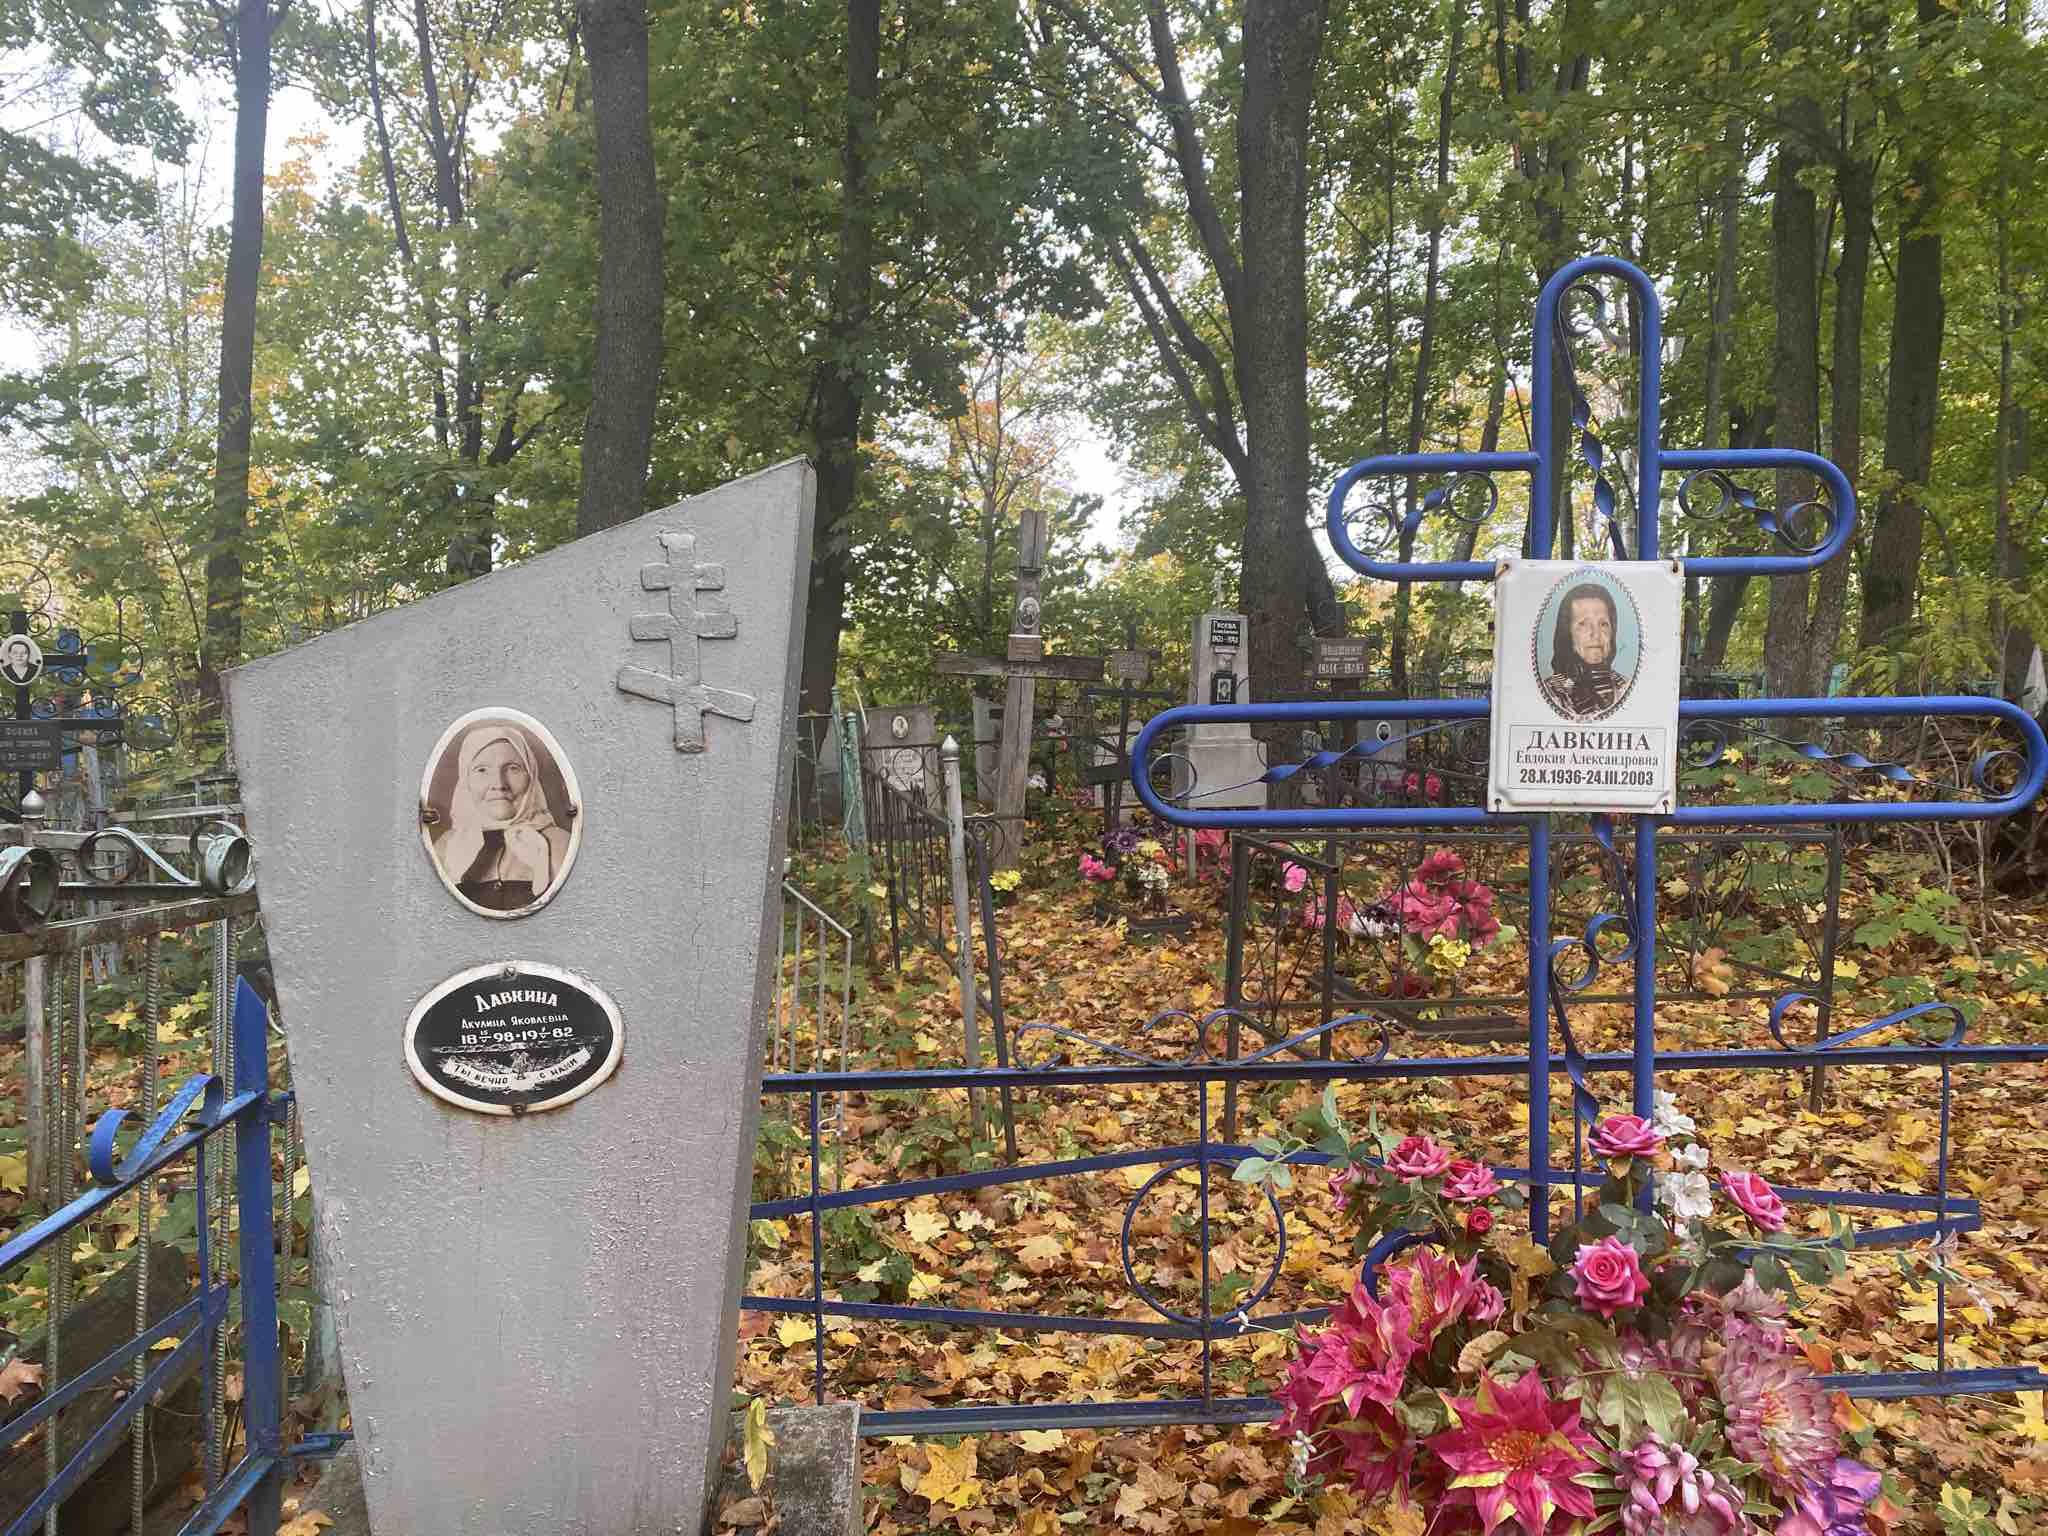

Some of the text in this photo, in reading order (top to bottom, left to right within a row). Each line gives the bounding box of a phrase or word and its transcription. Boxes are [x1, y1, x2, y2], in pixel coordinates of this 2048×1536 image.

[1526, 730, 1651, 752] ДАВКИНА
[1515, 750, 1659, 770] Евдокия Александровна
